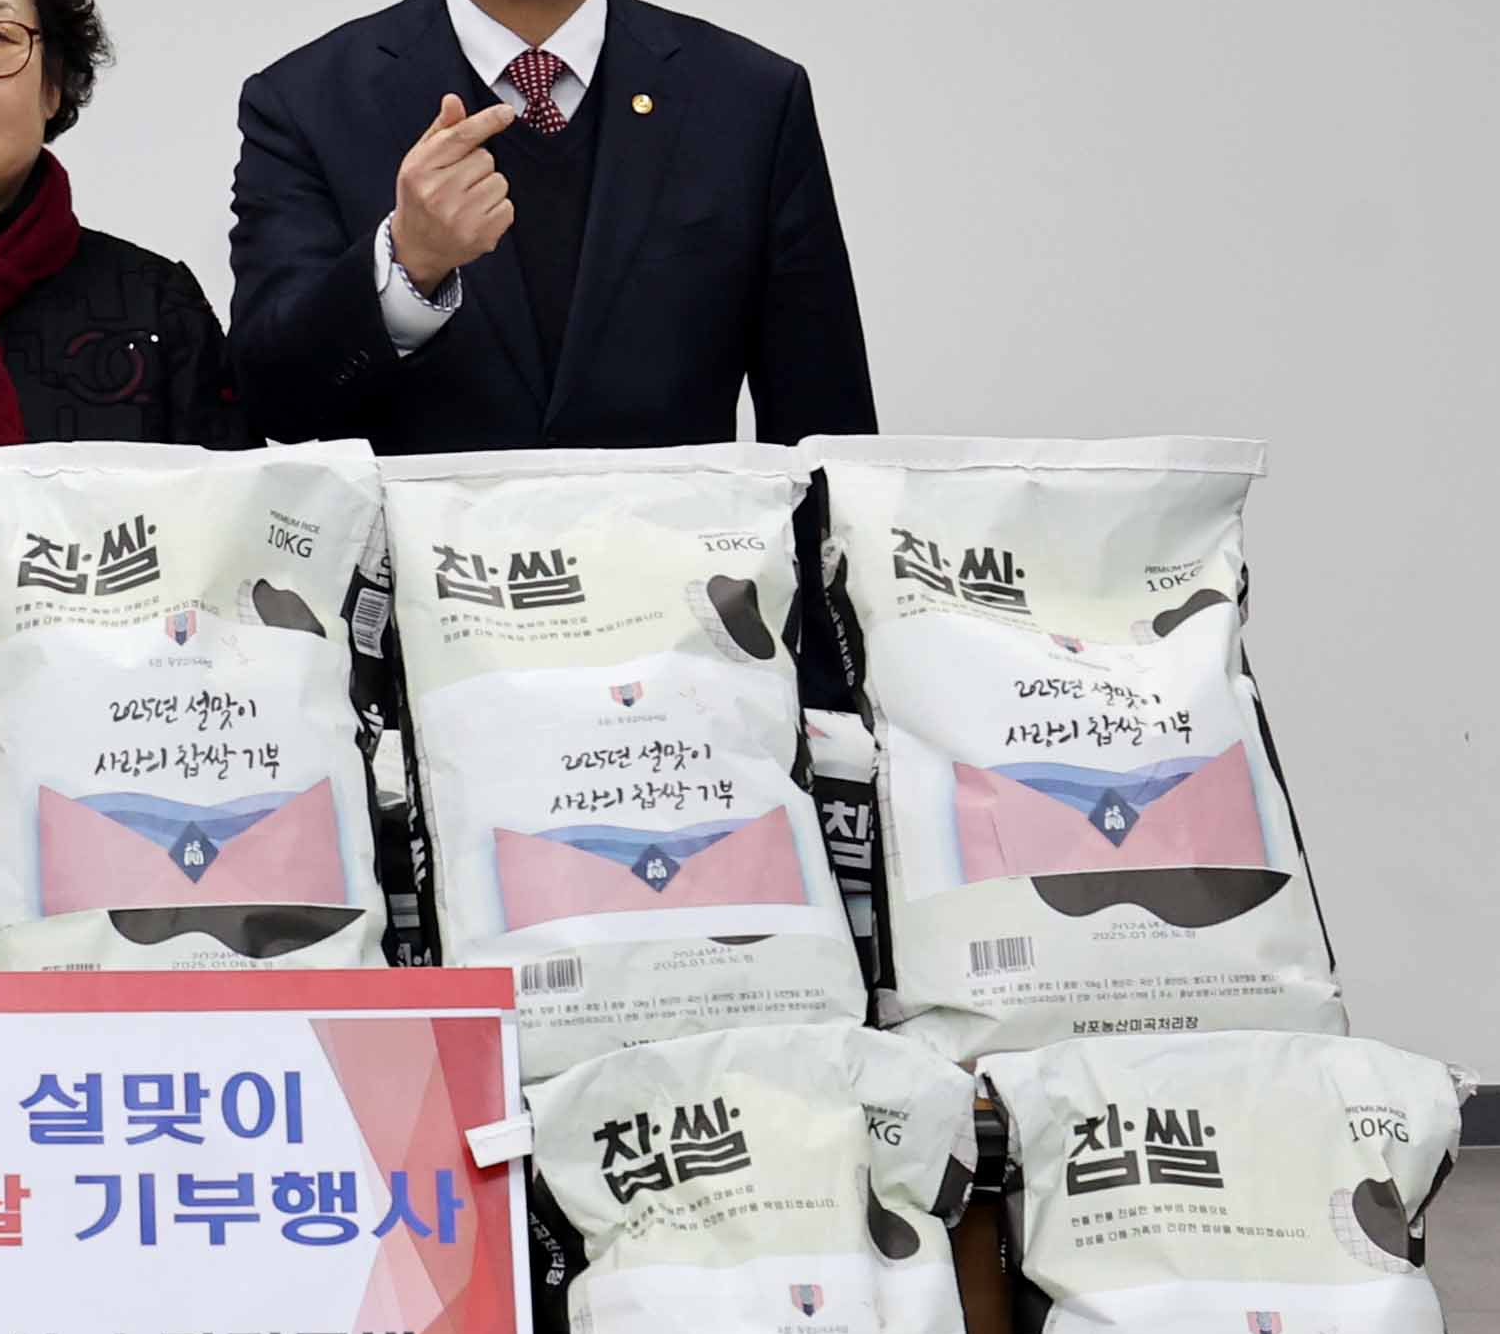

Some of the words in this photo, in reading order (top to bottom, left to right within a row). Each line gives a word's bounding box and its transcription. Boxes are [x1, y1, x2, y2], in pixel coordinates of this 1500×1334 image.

[17, 514, 161, 596] 찹쌀
[268, 523, 314, 559] 10KG
[705, 536, 766, 553] 10KG
[432, 545, 586, 611] 찹쌀
[891, 528, 1032, 615] 찹쌀
[109, 697, 178, 724] 2025년
[185, 691, 257, 730] 설맞이
[1015, 679, 1084, 699] 2025년
[1092, 681, 1163, 708] 설맞이
[1005, 720, 1079, 747] 사랑의
[1086, 714, 1147, 747] 찹쌀
[1154, 711, 1192, 744] 기부
[95, 747, 167, 775] 사랑의
[175, 742, 238, 778] 찹쌀
[243, 743, 280, 780] 기부
[561, 746, 631, 771] 2025년
[638, 740, 713, 773] 설맞이
[550, 787, 623, 814] 사랑의
[632, 782, 692, 813] 찹쌀
[697, 780, 735, 809] 기부
[1072, 1016, 1199, 1034] 남포농산미곡처리장
[18, 1068, 305, 1145] 설맞이
[865, 1114, 903, 1146] KG
[1349, 1117, 1410, 1144] 10KG
[593, 1096, 752, 1205] 찹쌀
[1066, 1103, 1224, 1196] 찹쌀
[73, 1168, 465, 1248] 기부행사
